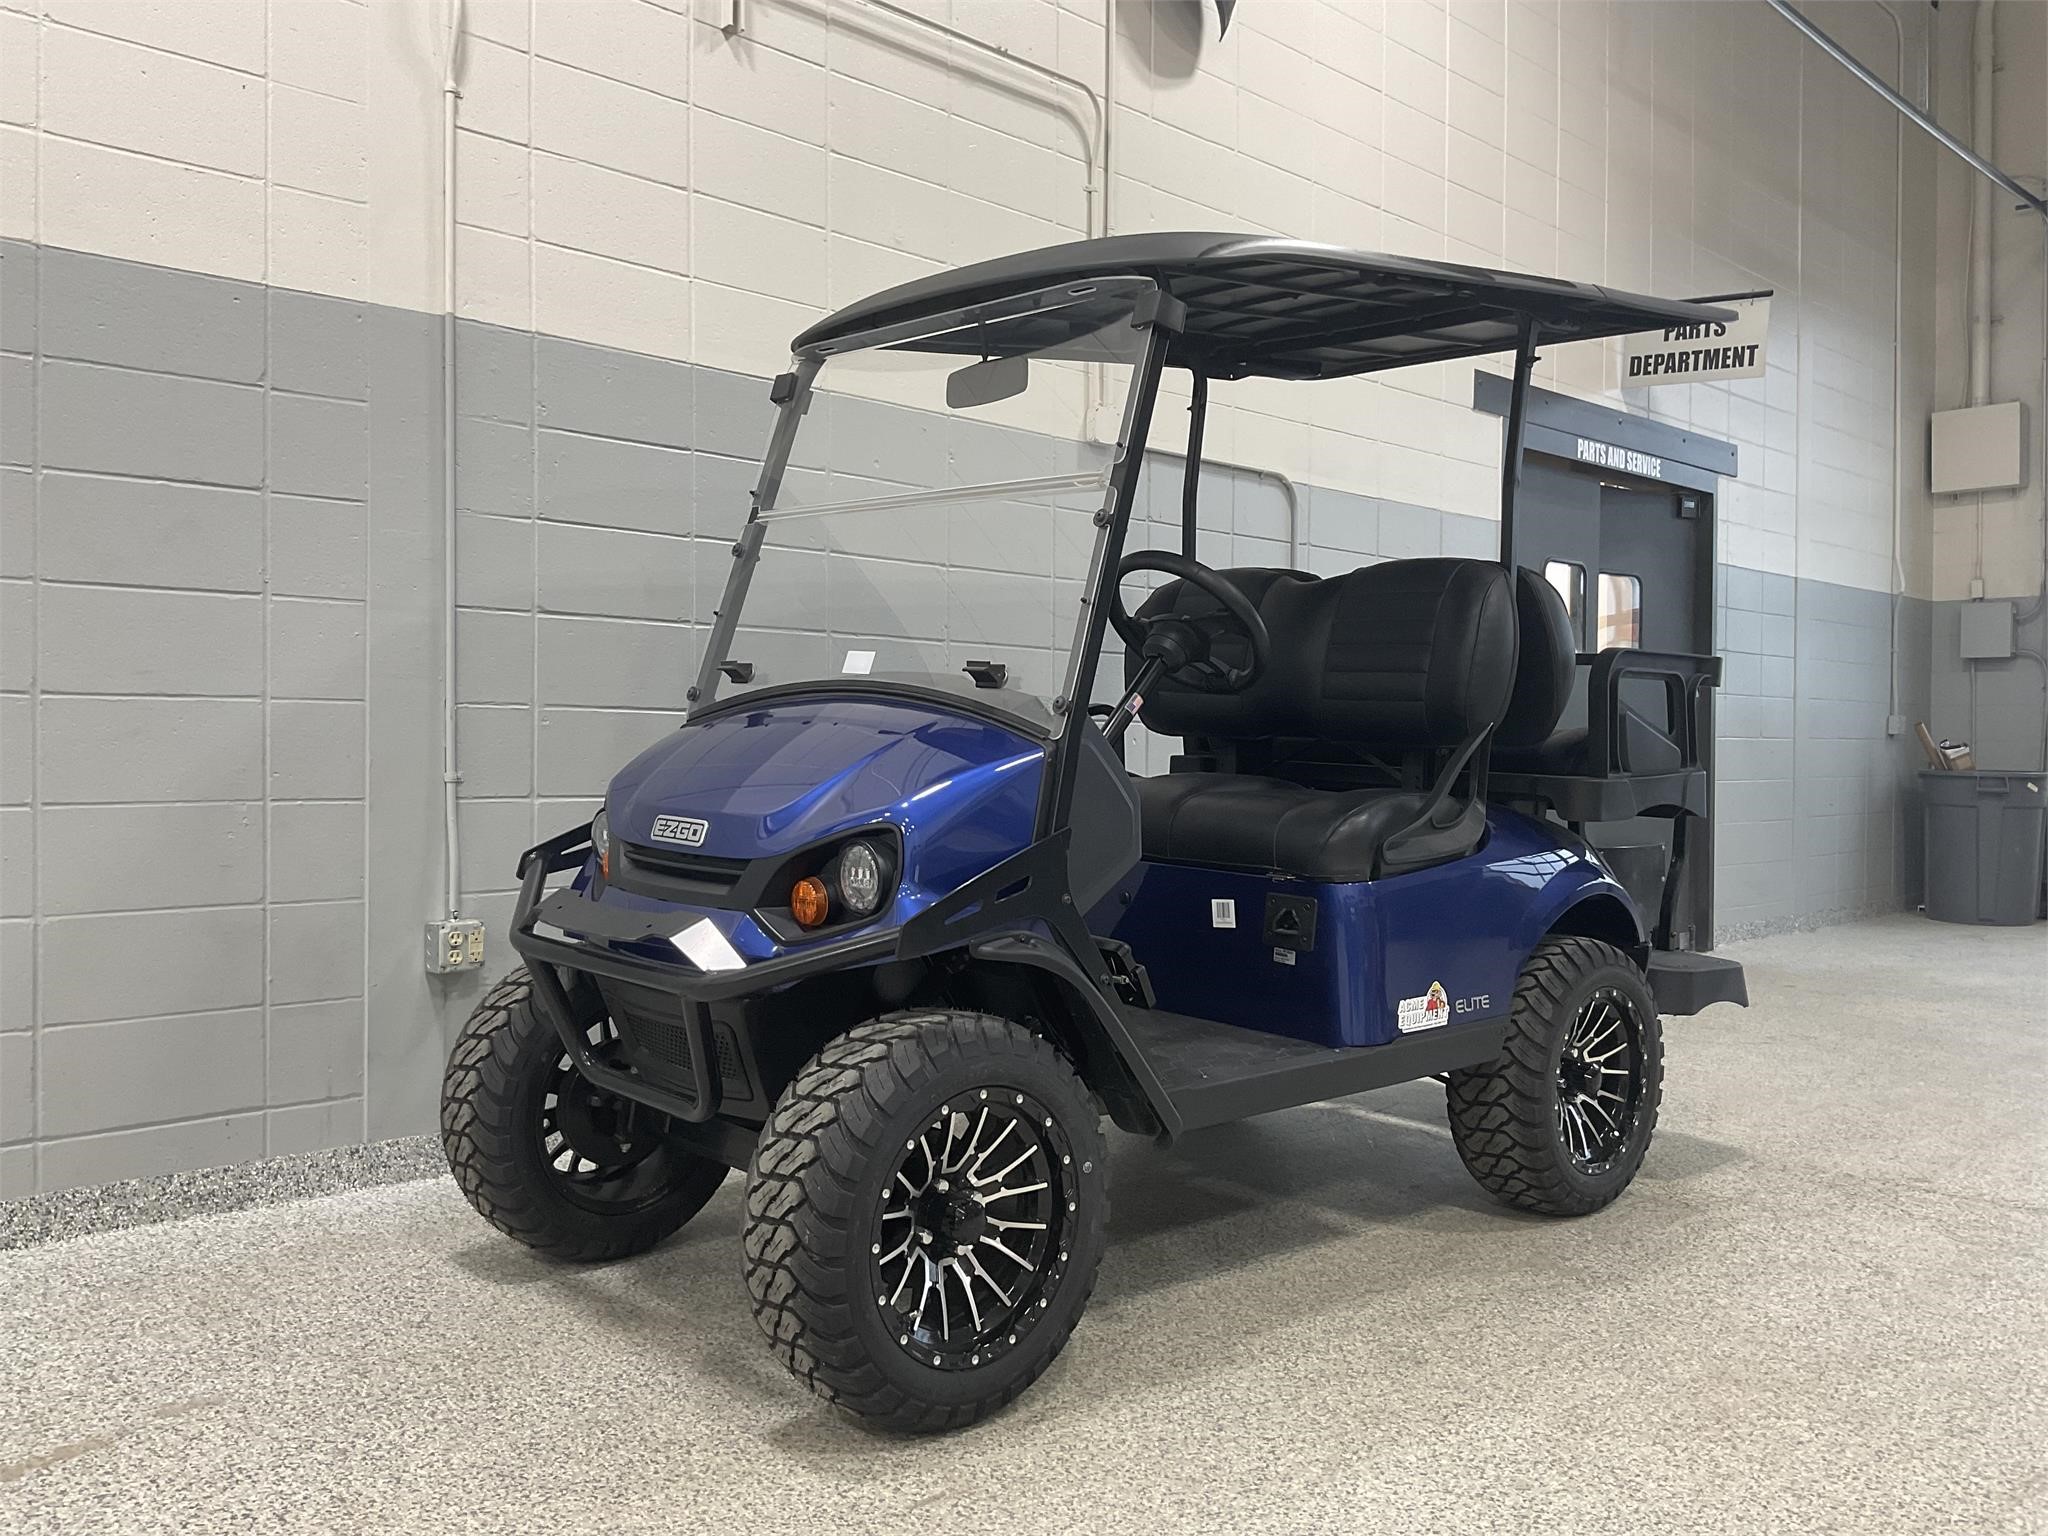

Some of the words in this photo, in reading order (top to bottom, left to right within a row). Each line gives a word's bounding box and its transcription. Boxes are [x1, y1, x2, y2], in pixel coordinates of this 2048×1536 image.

[1663, 322, 1727, 342] PARTS
[1629, 344, 1760, 377] DEPARTMENT
[1577, 438, 1606, 465] PARTS
[1607, 446, 1625, 469] AND
[1626, 451, 1661, 478] SERVICE
[1399, 998, 1425, 1014] ACME
[1455, 994, 1490, 1013] ELITE
[1399, 1008, 1449, 1027] EQUIPMENT
